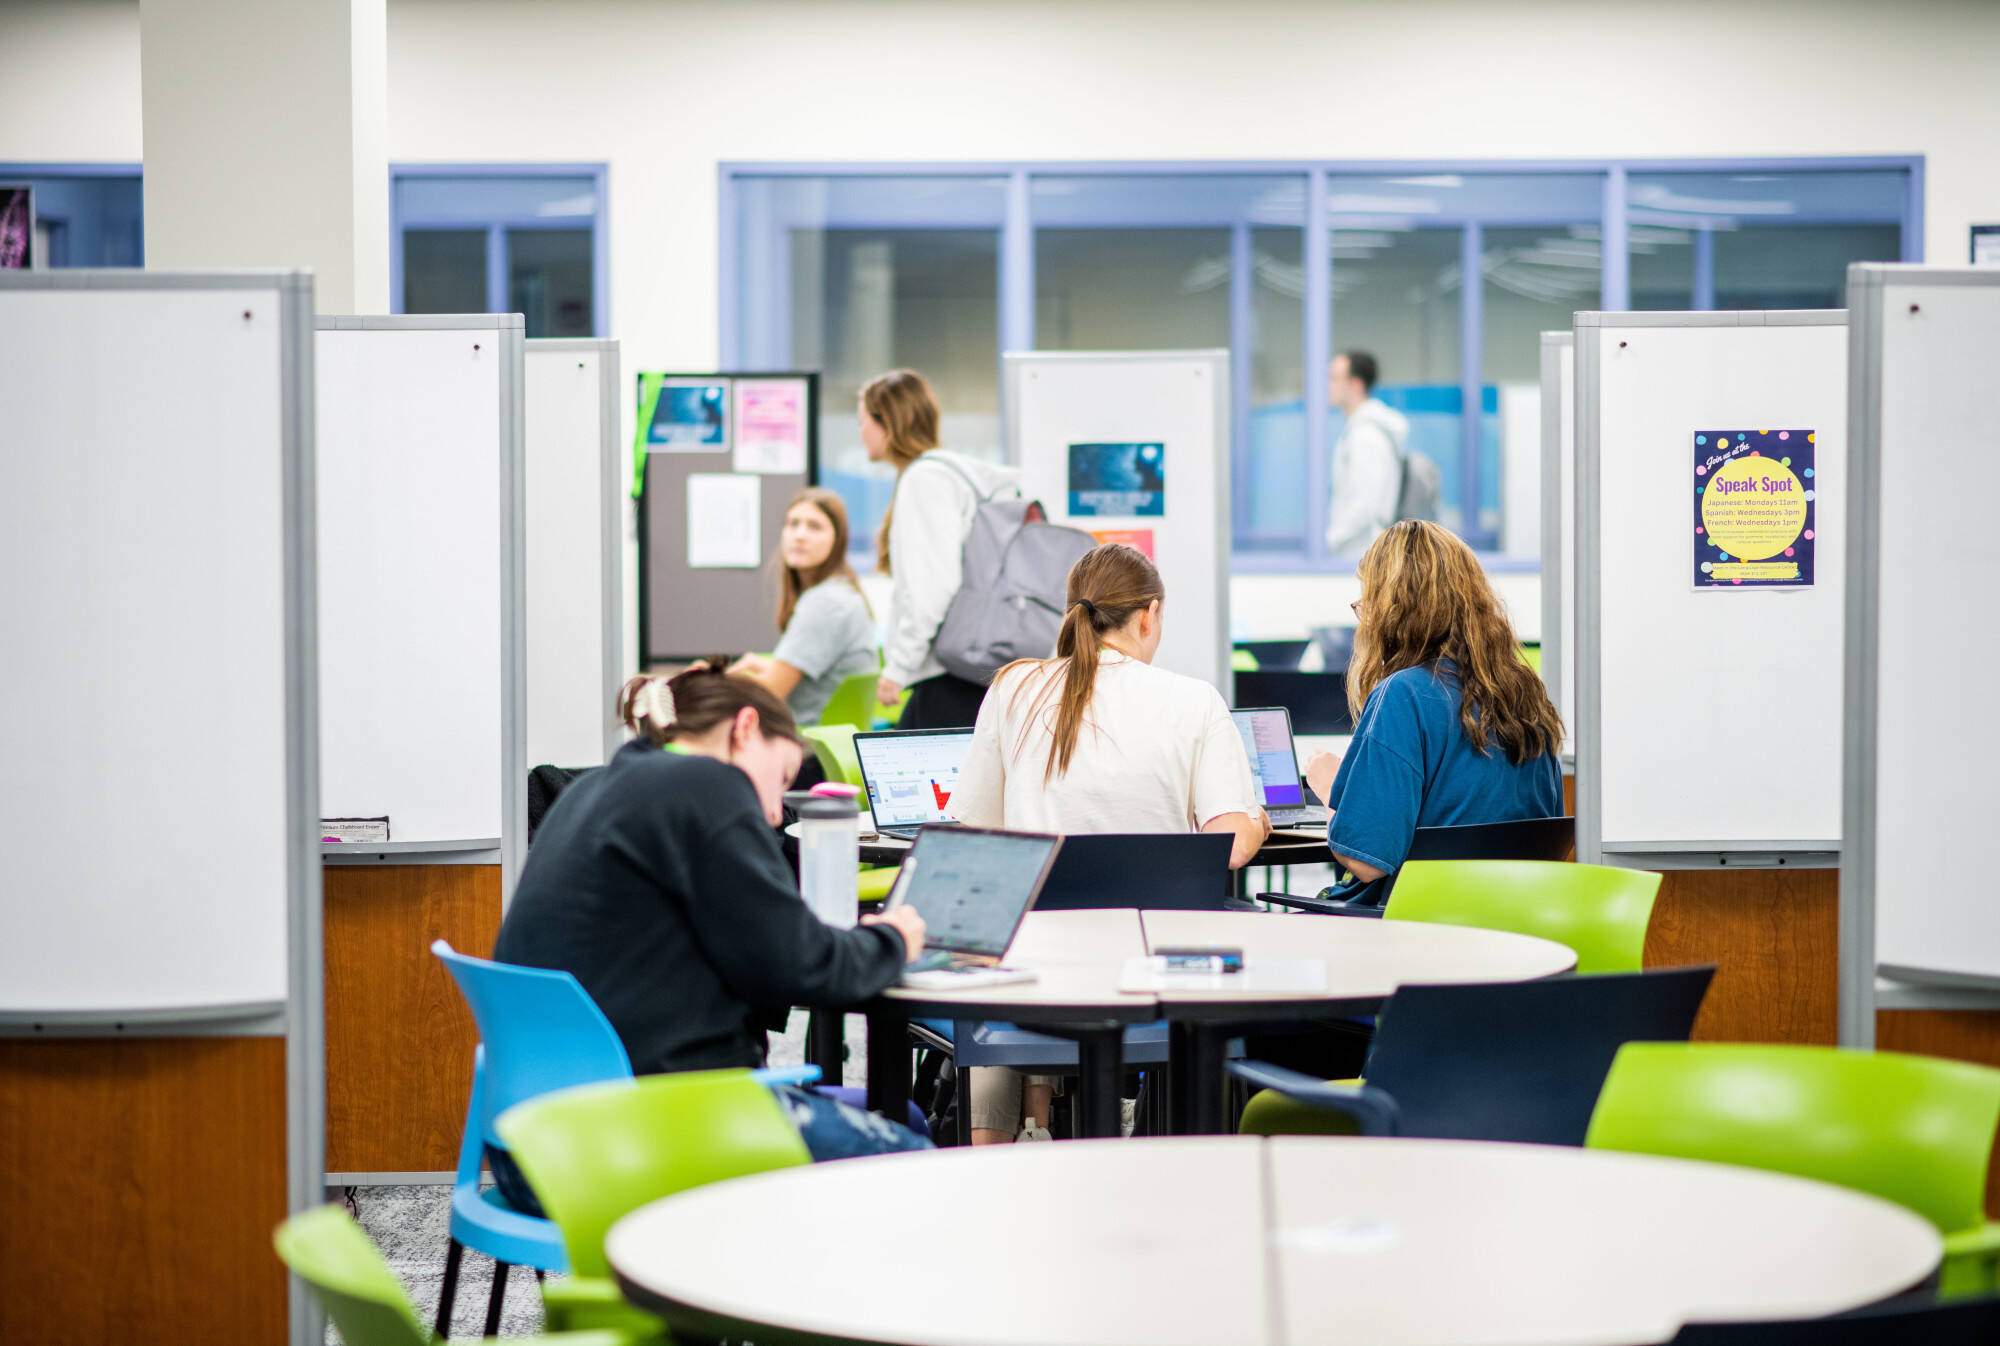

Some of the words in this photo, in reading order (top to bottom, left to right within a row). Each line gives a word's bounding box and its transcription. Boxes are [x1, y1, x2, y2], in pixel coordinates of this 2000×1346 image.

[1706, 456, 1723, 470] Join
[1731, 445, 1740, 456] at
[1739, 441, 1750, 452] the
[1716, 477, 1758, 496] Speak
[1761, 476, 1793, 496] Spot
[1707, 499, 1743, 507] Japanese:
[1744, 499, 1778, 507] Mondays
[1705, 509, 1736, 517] Spanish:
[1737, 509, 1783, 517] Wednesdays
[1735, 519, 1781, 527] Wednesdays
[1782, 519, 1798, 527] 1pm
